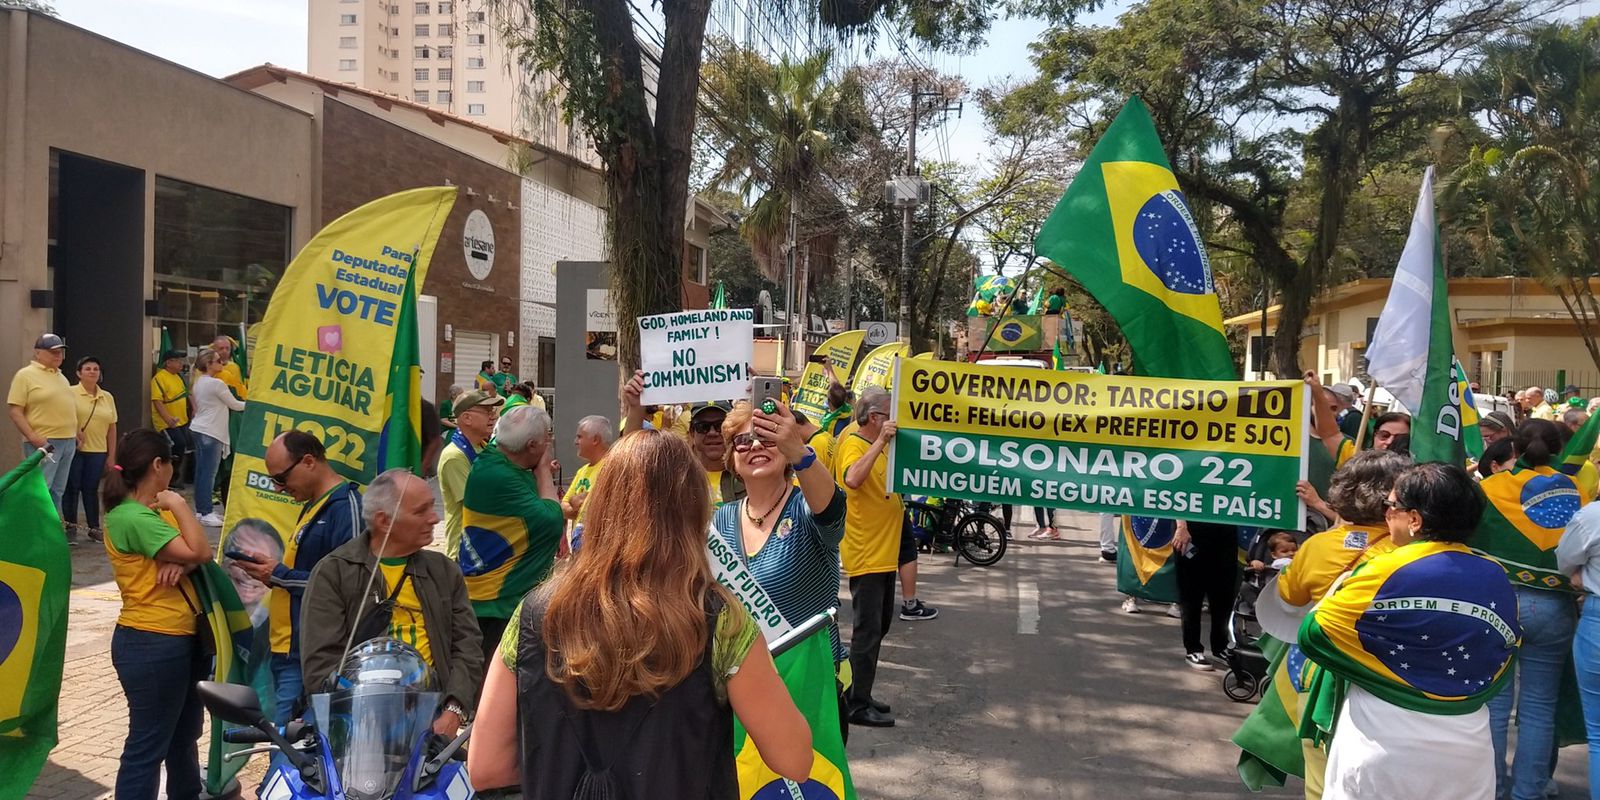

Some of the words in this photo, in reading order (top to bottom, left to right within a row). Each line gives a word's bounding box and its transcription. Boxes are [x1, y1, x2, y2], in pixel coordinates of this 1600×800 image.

[1166, 193, 1192, 220] ORDEM
[331, 249, 408, 279] Deputada
[381, 245, 413, 263] Para
[336, 268, 404, 296] Estadual
[316, 283, 397, 327] VOTE
[640, 317, 668, 330] GOD,
[670, 311, 728, 327] HOMELAND
[730, 310, 753, 321] AND
[667, 327, 710, 343] FAMILY
[274, 344, 375, 392] LETICIA
[672, 348, 696, 367] NO
[831, 358, 849, 370] OTE
[868, 365, 887, 376] VOTE
[643, 363, 741, 389] COMMUNISM
[270, 369, 372, 416] AGUIAR
[912, 369, 1097, 407] GOVERNADOR:
[1107, 386, 1228, 412] TARCISIO
[1246, 389, 1285, 417] 10
[909, 401, 960, 424] VICE:
[968, 403, 1046, 430] FELÍCIO
[1053, 413, 1088, 436] (EX
[1096, 416, 1198, 441] PREFEITO
[1207, 422, 1237, 443] DE
[1244, 424, 1291, 452] SJC)
[920, 434, 1184, 481] BOLSONARO
[1200, 456, 1253, 487] 22
[902, 468, 1022, 497] NINGUÉM
[1030, 479, 1135, 507] SEGURA
[1143, 489, 1203, 513] ESSE
[1213, 491, 1281, 520] PAÍS!
[734, 570, 782, 628] FUTURO
[1374, 599, 1438, 610] ORDEM
[1451, 602, 1460, 612] E
[1471, 606, 1515, 643] PROGRES
[788, 780, 803, 800] ORD
